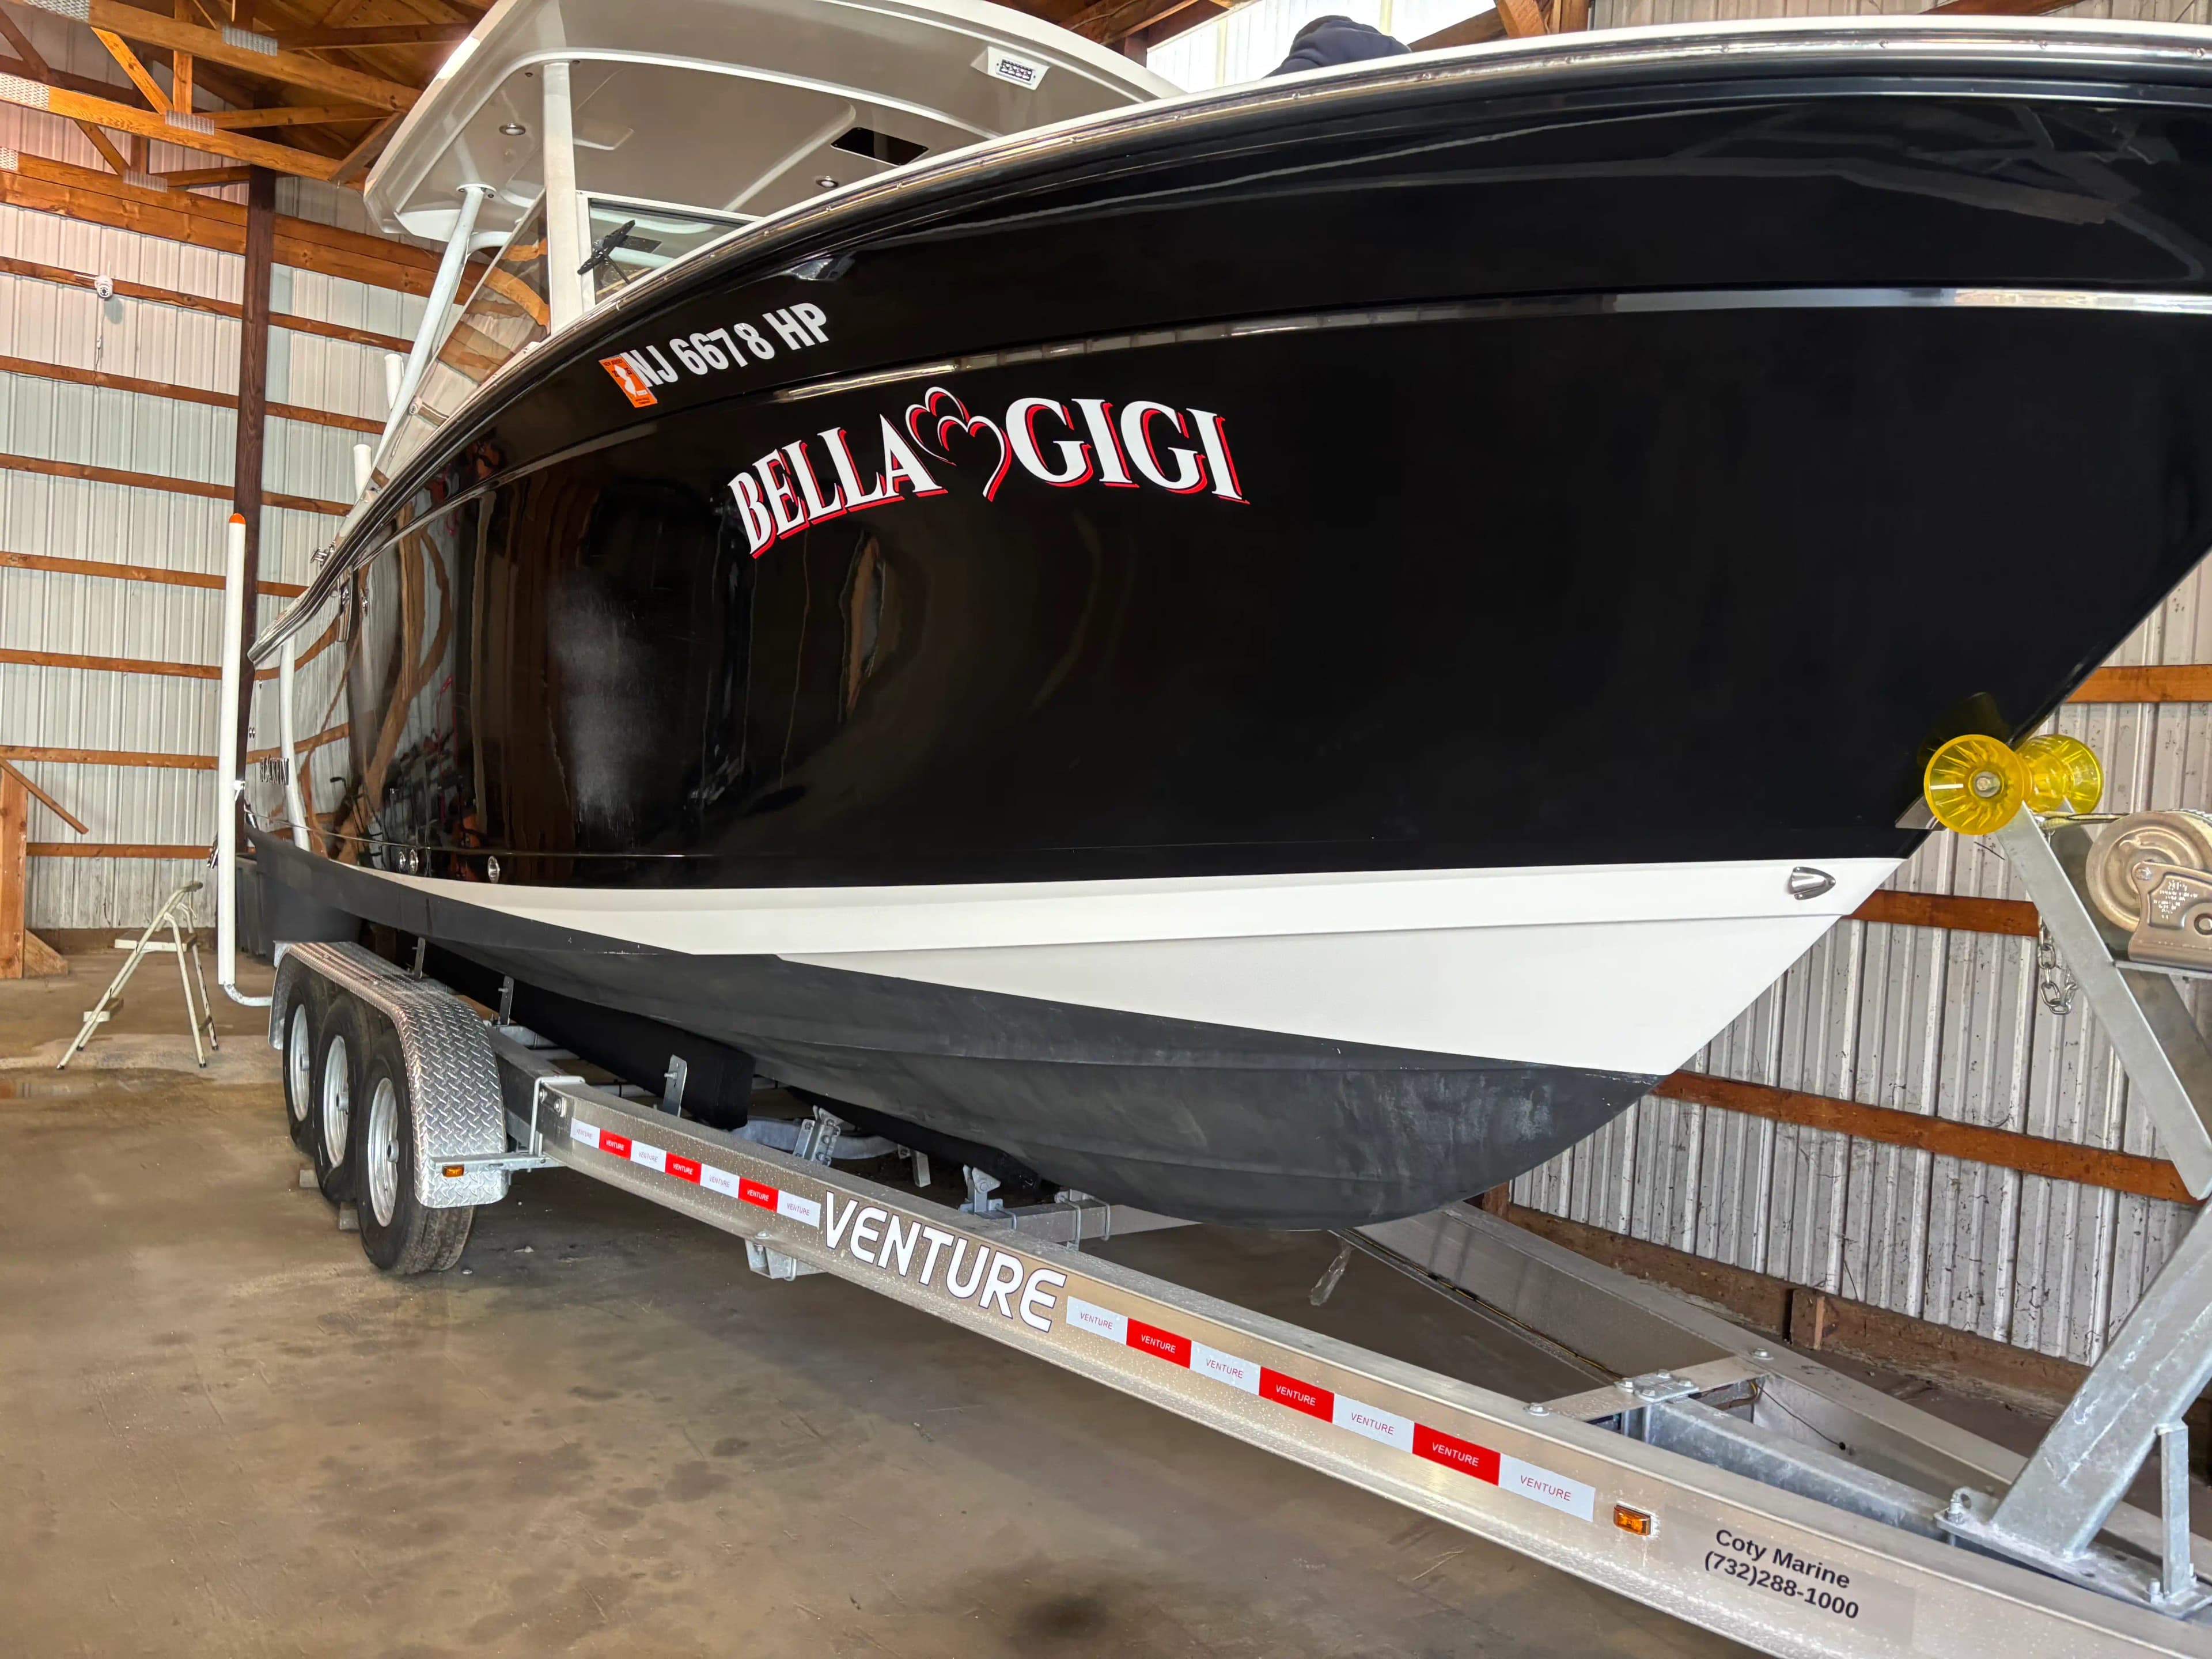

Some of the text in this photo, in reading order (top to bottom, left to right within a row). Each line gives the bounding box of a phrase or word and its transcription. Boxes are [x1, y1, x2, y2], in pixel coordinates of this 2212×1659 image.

[620, 303, 829, 388] NJ 6678 HP
[728, 397, 1250, 559] BELLA GIGI
[606, 1139, 624, 1151] VENTURE
[638, 1151, 658, 1162] VENTURE
[673, 1162, 694, 1175] VENTURE
[709, 1175, 730, 1188] VENTURE
[747, 1189, 769, 1202] VENTURE
[787, 1202, 810, 1216] VENTURE
[825, 1190, 1067, 1333] VENTURE
[1080, 1312, 1571, 1501] VENTURE VENTURE VENTURE VENTURE VENTURE VENTURE VENTURE
[1705, 1551, 1859, 1619] (732)288-1000
[1715, 1529, 1850, 1588] Coty Marine
